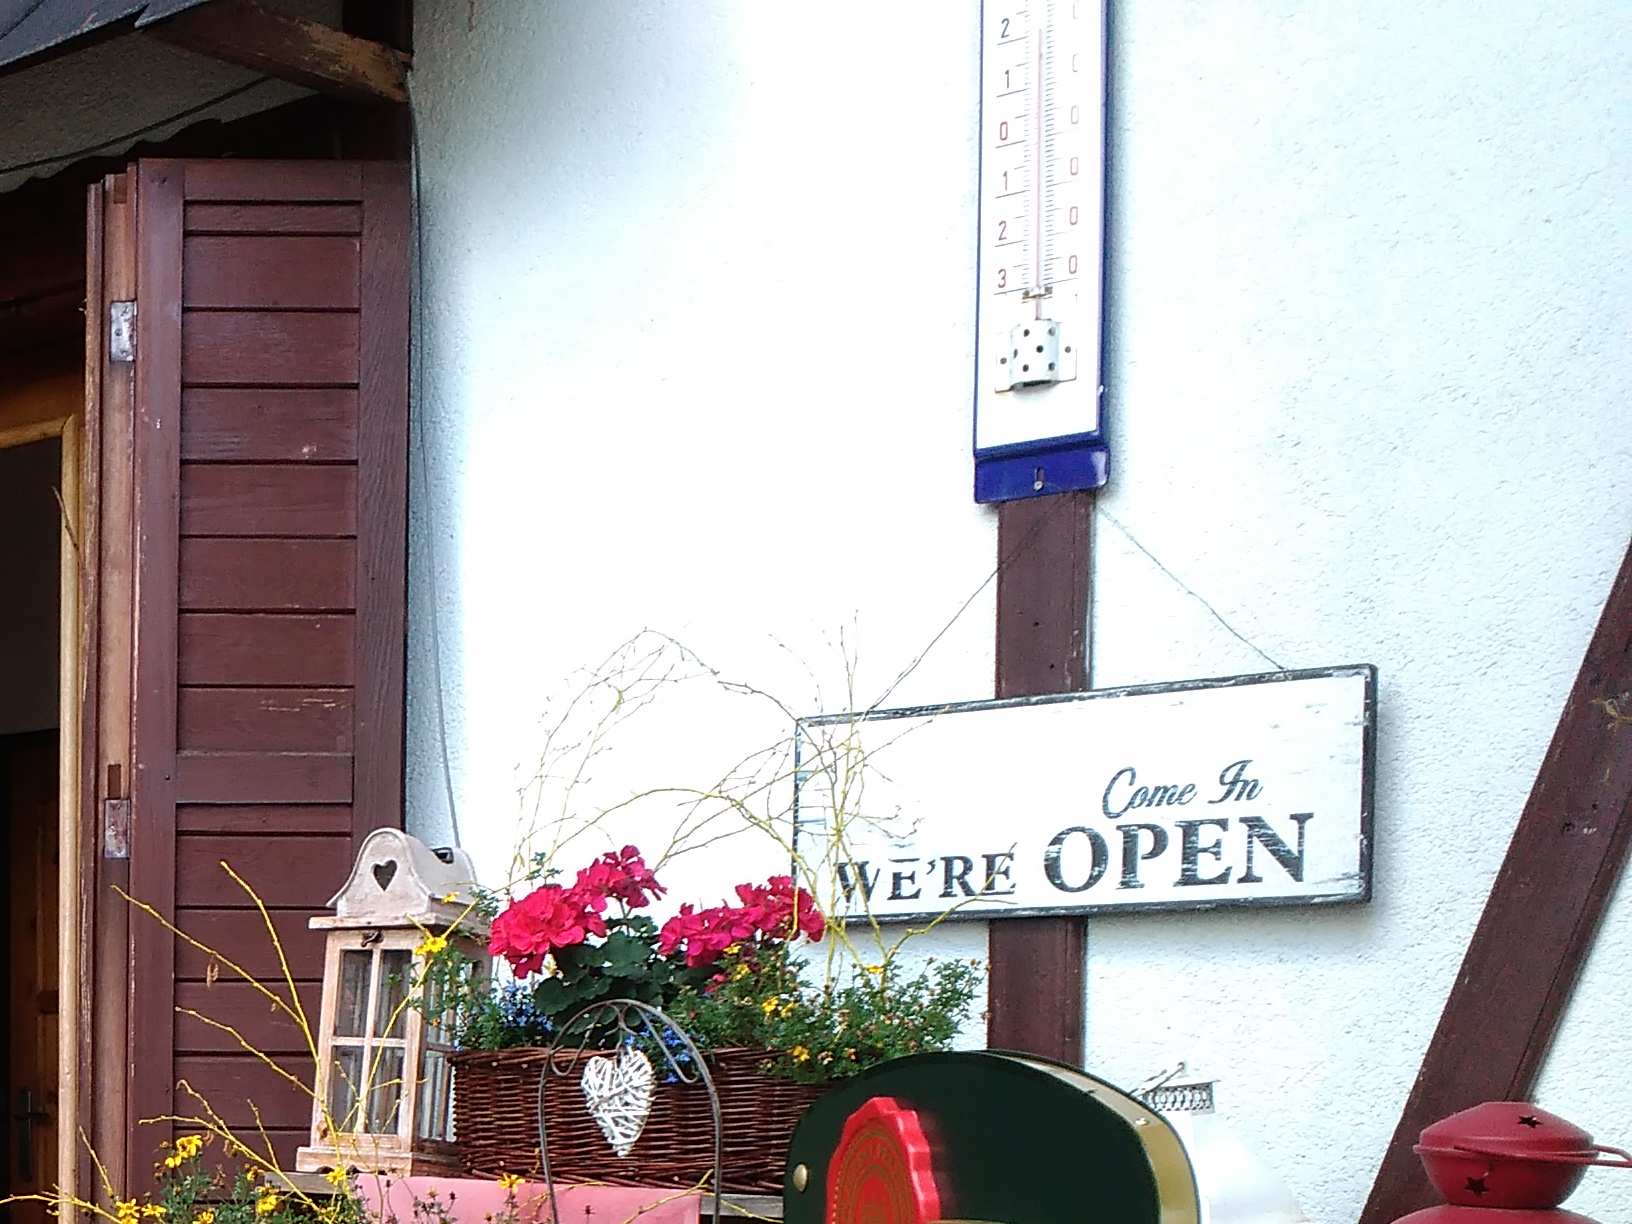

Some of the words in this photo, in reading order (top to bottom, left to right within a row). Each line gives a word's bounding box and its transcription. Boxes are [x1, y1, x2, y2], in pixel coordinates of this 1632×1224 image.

[1000, 18, 1010, 39] 2
[1004, 69, 1010, 89] 1
[999, 121, 1008, 141] 0
[1002, 170, 1008, 191] 1
[1070, 156, 1079, 176] 0
[998, 220, 1008, 241] 2
[1069, 206, 1078, 226] 0
[998, 268, 1007, 288] 3
[1069, 254, 1078, 274] 0
[1101, 766, 1197, 819] Come
[1207, 759, 1264, 805] In
[1043, 812, 1314, 893] OPEN
